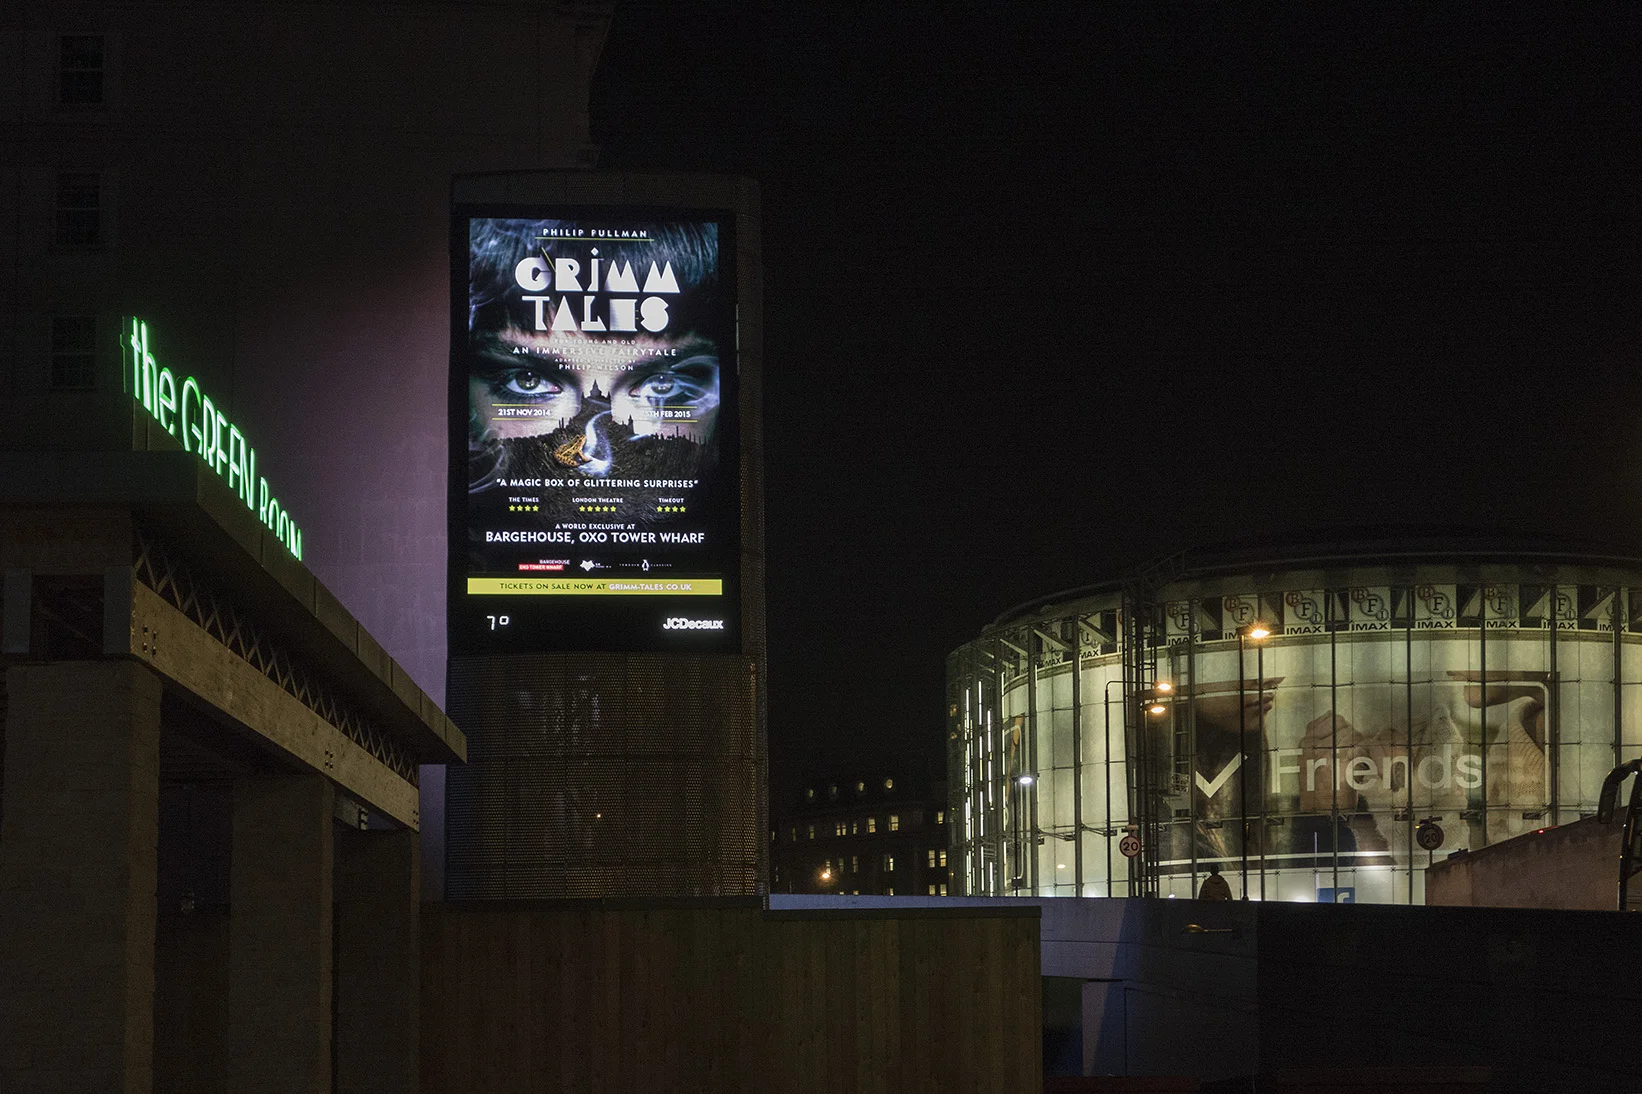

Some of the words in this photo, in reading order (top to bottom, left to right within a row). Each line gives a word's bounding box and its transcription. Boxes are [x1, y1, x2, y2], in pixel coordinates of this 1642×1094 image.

[542, 228, 584, 237] PHILIP
[591, 229, 648, 238] PULLMAN
[515, 247, 681, 293] GRIMM
[522, 295, 669, 332] TALES
[535, 347, 605, 355] IMMERSIVE
[611, 348, 678, 357] FAIRYTALE
[130, 315, 177, 436] the
[498, 408, 515, 416] 21ST
[674, 410, 691, 418] 2015
[509, 478, 541, 487] MAGIC
[544, 479, 564, 487] BOX
[567, 479, 580, 487] OF
[583, 479, 641, 488] GLITTERING
[485, 531, 575, 544] BARGEHOUSE,
[579, 532, 608, 543] OXO
[611, 532, 657, 543] TOWER
[660, 532, 705, 543] WHARF
[500, 582, 534, 590] TICKETS
[608, 583, 692, 591] GRIMM-TALES.CO.UK
[663, 617, 724, 630] JCDecaux
[1351, 622, 1388, 631] IMAX
[1417, 620, 1454, 629] IMAX
[1485, 620, 1517, 629] MAX
[1286, 626, 1322, 635] IMAX
[1080, 649, 1099, 659] MAX
[1271, 744, 1483, 794] Friends
[1423, 832, 1438, 843] 20
[1122, 841, 1139, 852] 20
